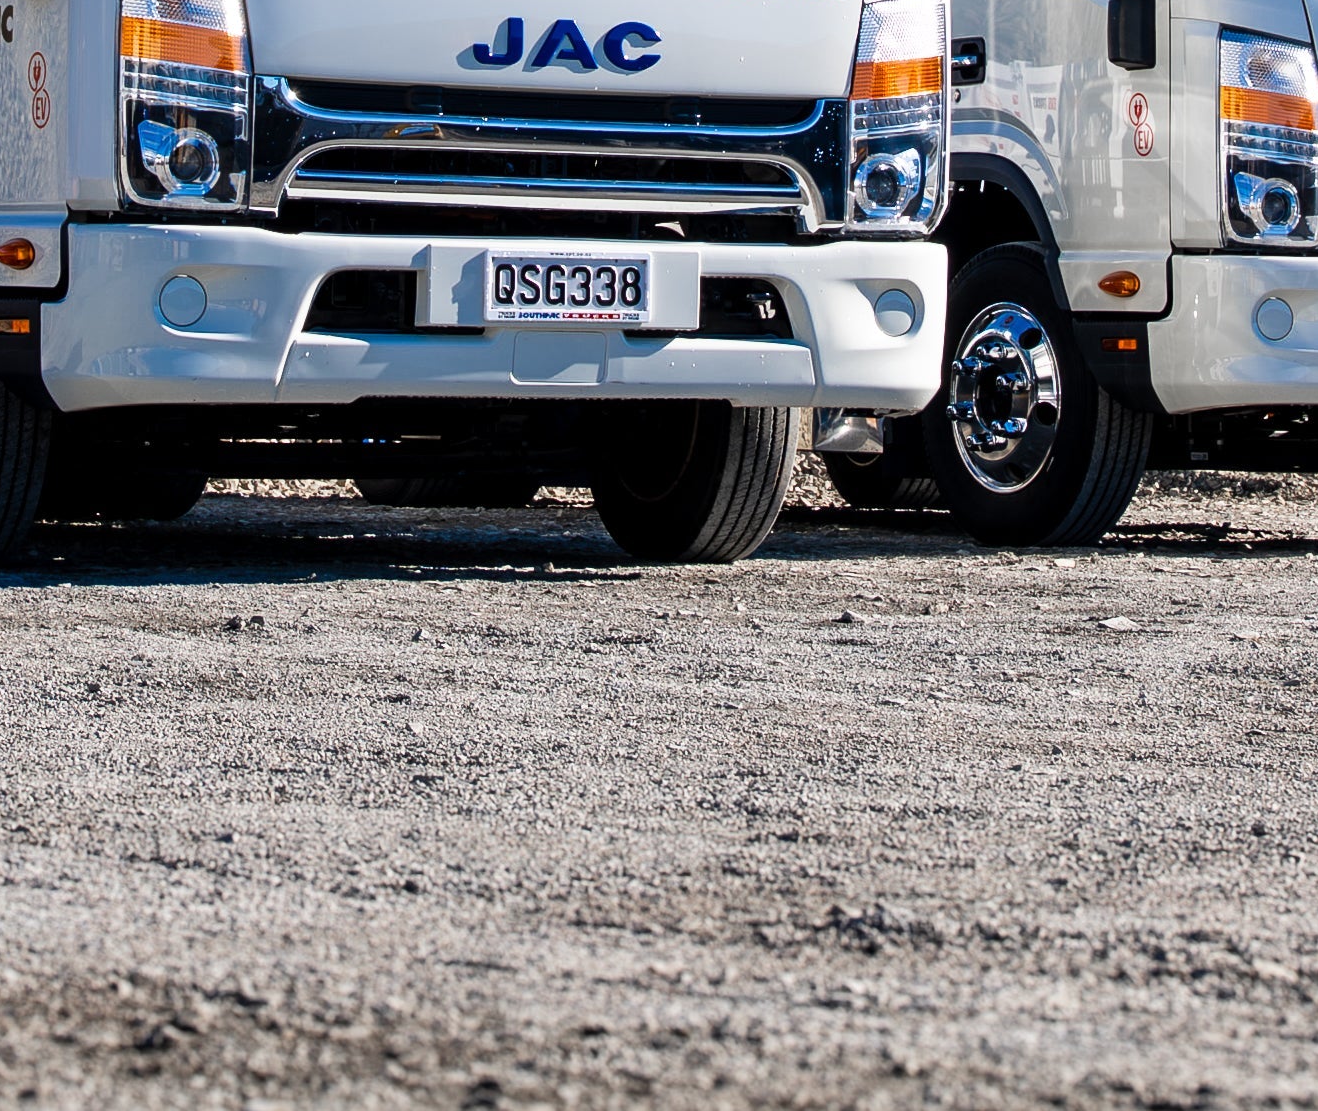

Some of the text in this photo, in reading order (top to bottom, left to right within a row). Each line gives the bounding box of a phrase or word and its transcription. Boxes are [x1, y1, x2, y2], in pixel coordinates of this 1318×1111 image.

[473, 17, 661, 71] JAC
[36, 97, 47, 121] EV
[1138, 130, 1150, 149] EV
[494, 263, 642, 307] QSG338
